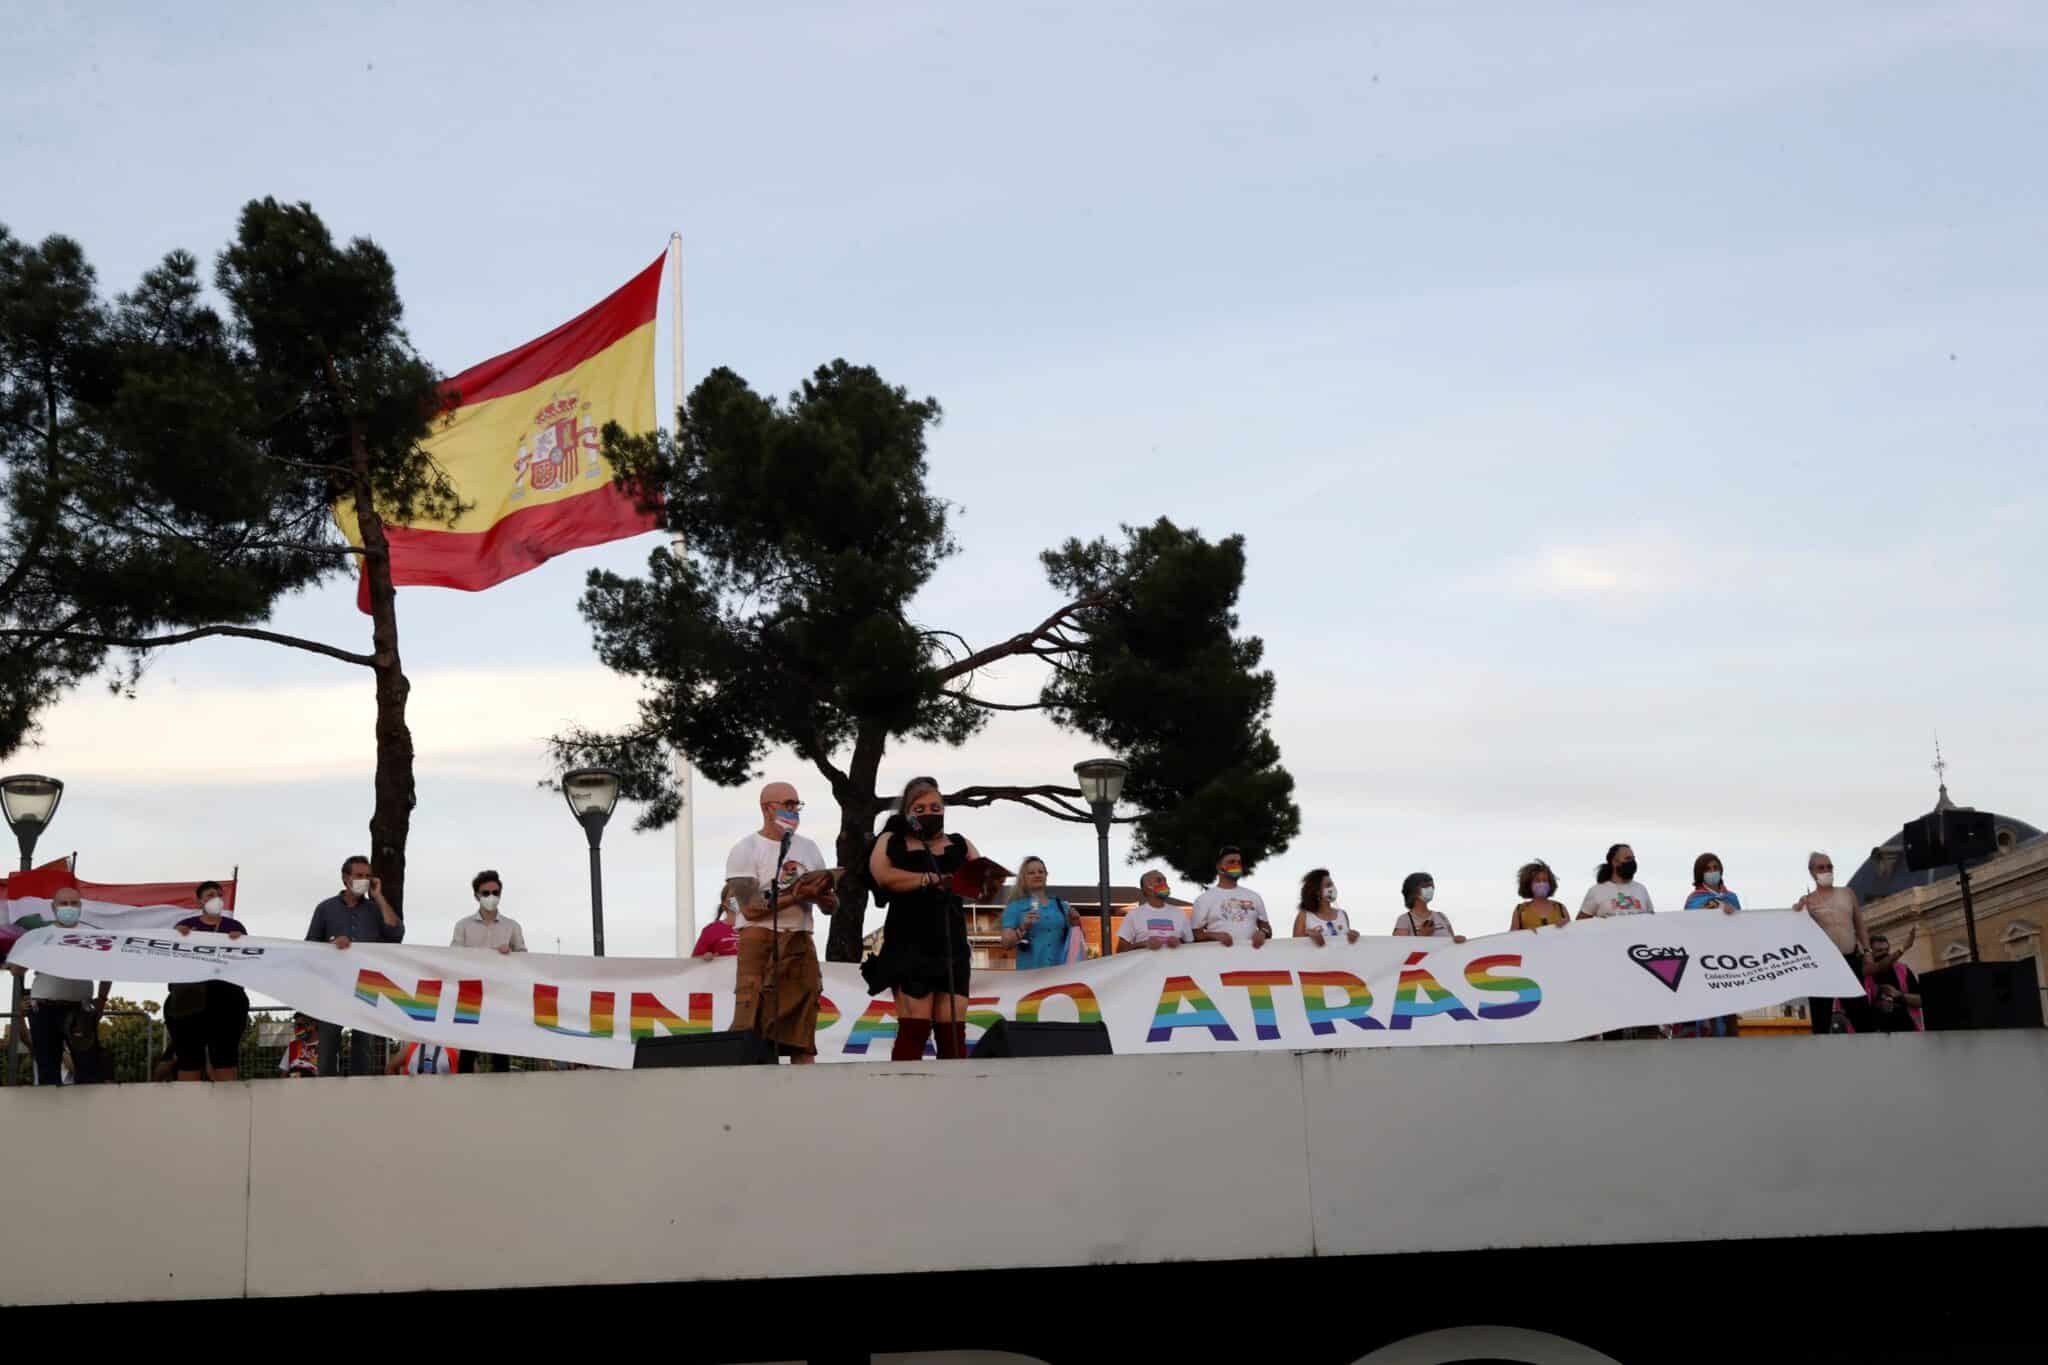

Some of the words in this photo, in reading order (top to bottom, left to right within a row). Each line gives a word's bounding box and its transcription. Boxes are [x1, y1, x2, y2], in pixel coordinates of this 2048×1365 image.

[1628, 944, 1687, 960] COGAM
[1700, 944, 1808, 971] COGAM
[1707, 961, 1820, 990] www.cogam.es
[354, 968, 483, 1024] NI
[533, 983, 713, 1043] UN
[1146, 952, 1542, 1042] ATRÁS
